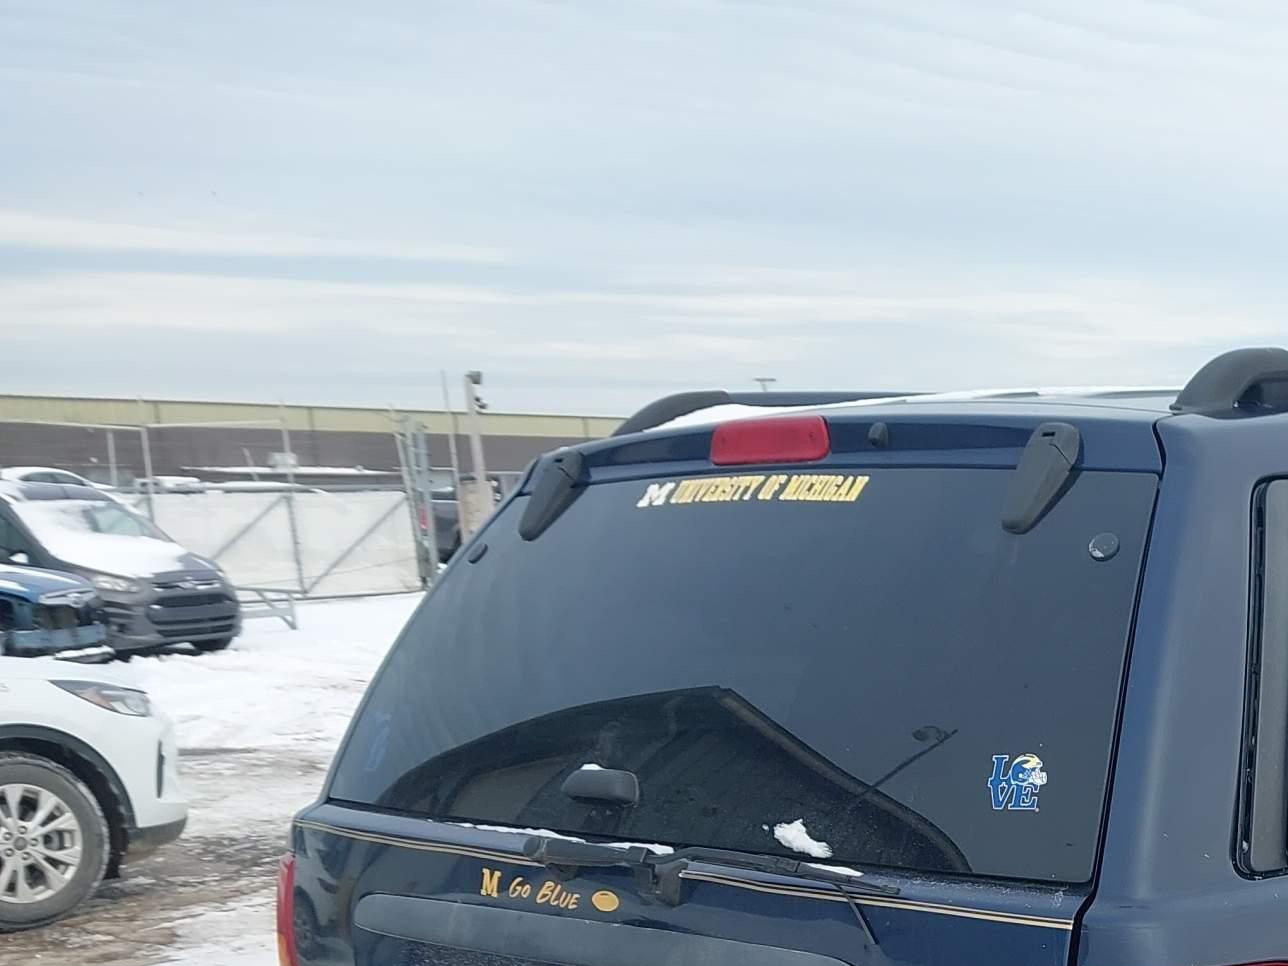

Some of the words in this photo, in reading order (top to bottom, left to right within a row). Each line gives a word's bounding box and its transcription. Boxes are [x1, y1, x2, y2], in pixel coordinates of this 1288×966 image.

[637, 482, 675, 507] M
[670, 475, 767, 504] UNIVERSITY
[757, 475, 785, 500] OF
[779, 475, 870, 502] MICHIGAN
[480, 868, 502, 898] M
